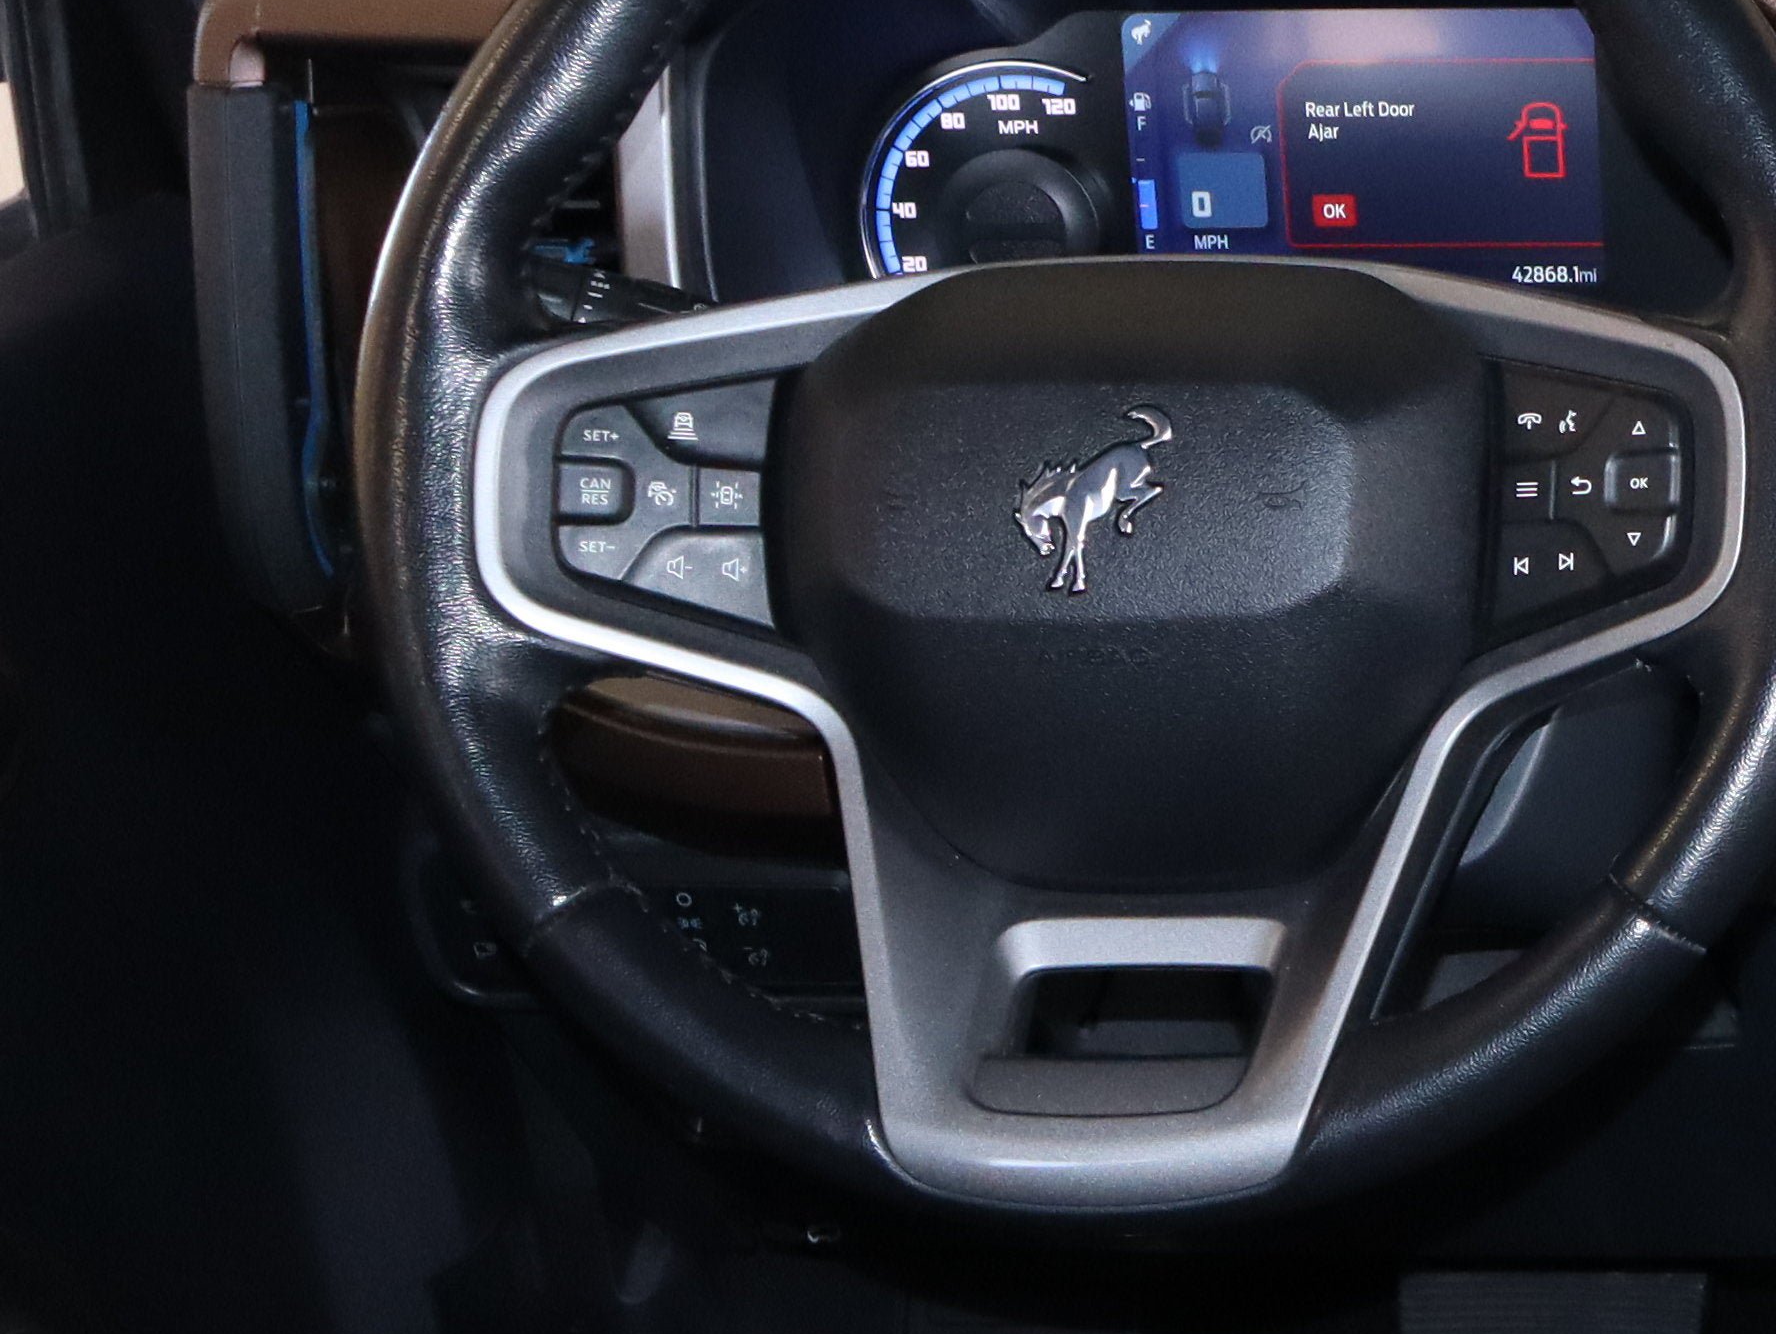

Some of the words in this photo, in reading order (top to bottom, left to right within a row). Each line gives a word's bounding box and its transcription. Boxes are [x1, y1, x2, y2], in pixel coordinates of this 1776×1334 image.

[986, 93, 1021, 111] 100
[1041, 97, 1077, 116] 120
[1305, 101, 1341, 118] Rear
[1343, 100, 1375, 118] Left
[1377, 100, 1415, 117] Door
[940, 112, 966, 130] 80
[997, 119, 1039, 135] MPH
[1137, 115, 1146, 131] F
[1308, 123, 1340, 142] Ajar
[904, 150, 930, 168] 60
[891, 201, 917, 219] 40
[1191, 191, 1212, 218] 0
[1323, 203, 1347, 219] OK
[1145, 234, 1155, 250] E
[1194, 234, 1230, 250] MPH
[901, 254, 928, 273] 20
[1511, 265, 1597, 283] 42868.1mi
[583, 429, 620, 442] SET+
[579, 478, 612, 490] CAN
[1629, 477, 1649, 490] OK
[581, 494, 609, 505] RES
